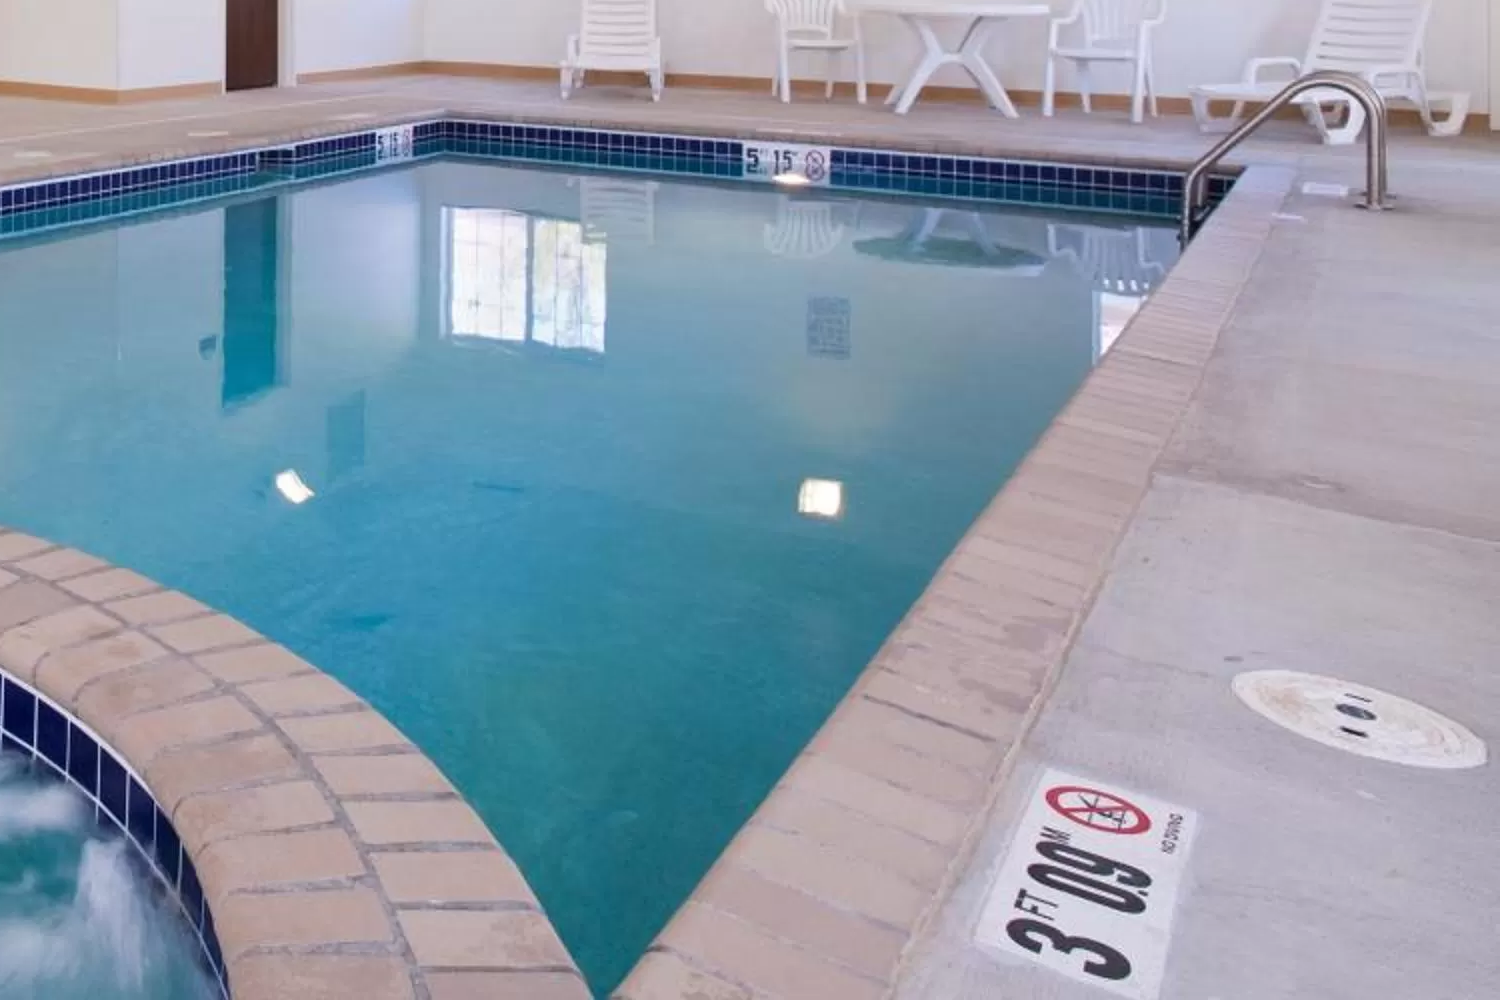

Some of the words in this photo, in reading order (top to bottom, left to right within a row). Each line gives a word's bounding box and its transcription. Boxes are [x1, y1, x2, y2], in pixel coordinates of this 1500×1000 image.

[1161, 840, 1176, 855] NO
[1014, 888, 1059, 921] FT
[1006, 917, 1132, 980] 3
